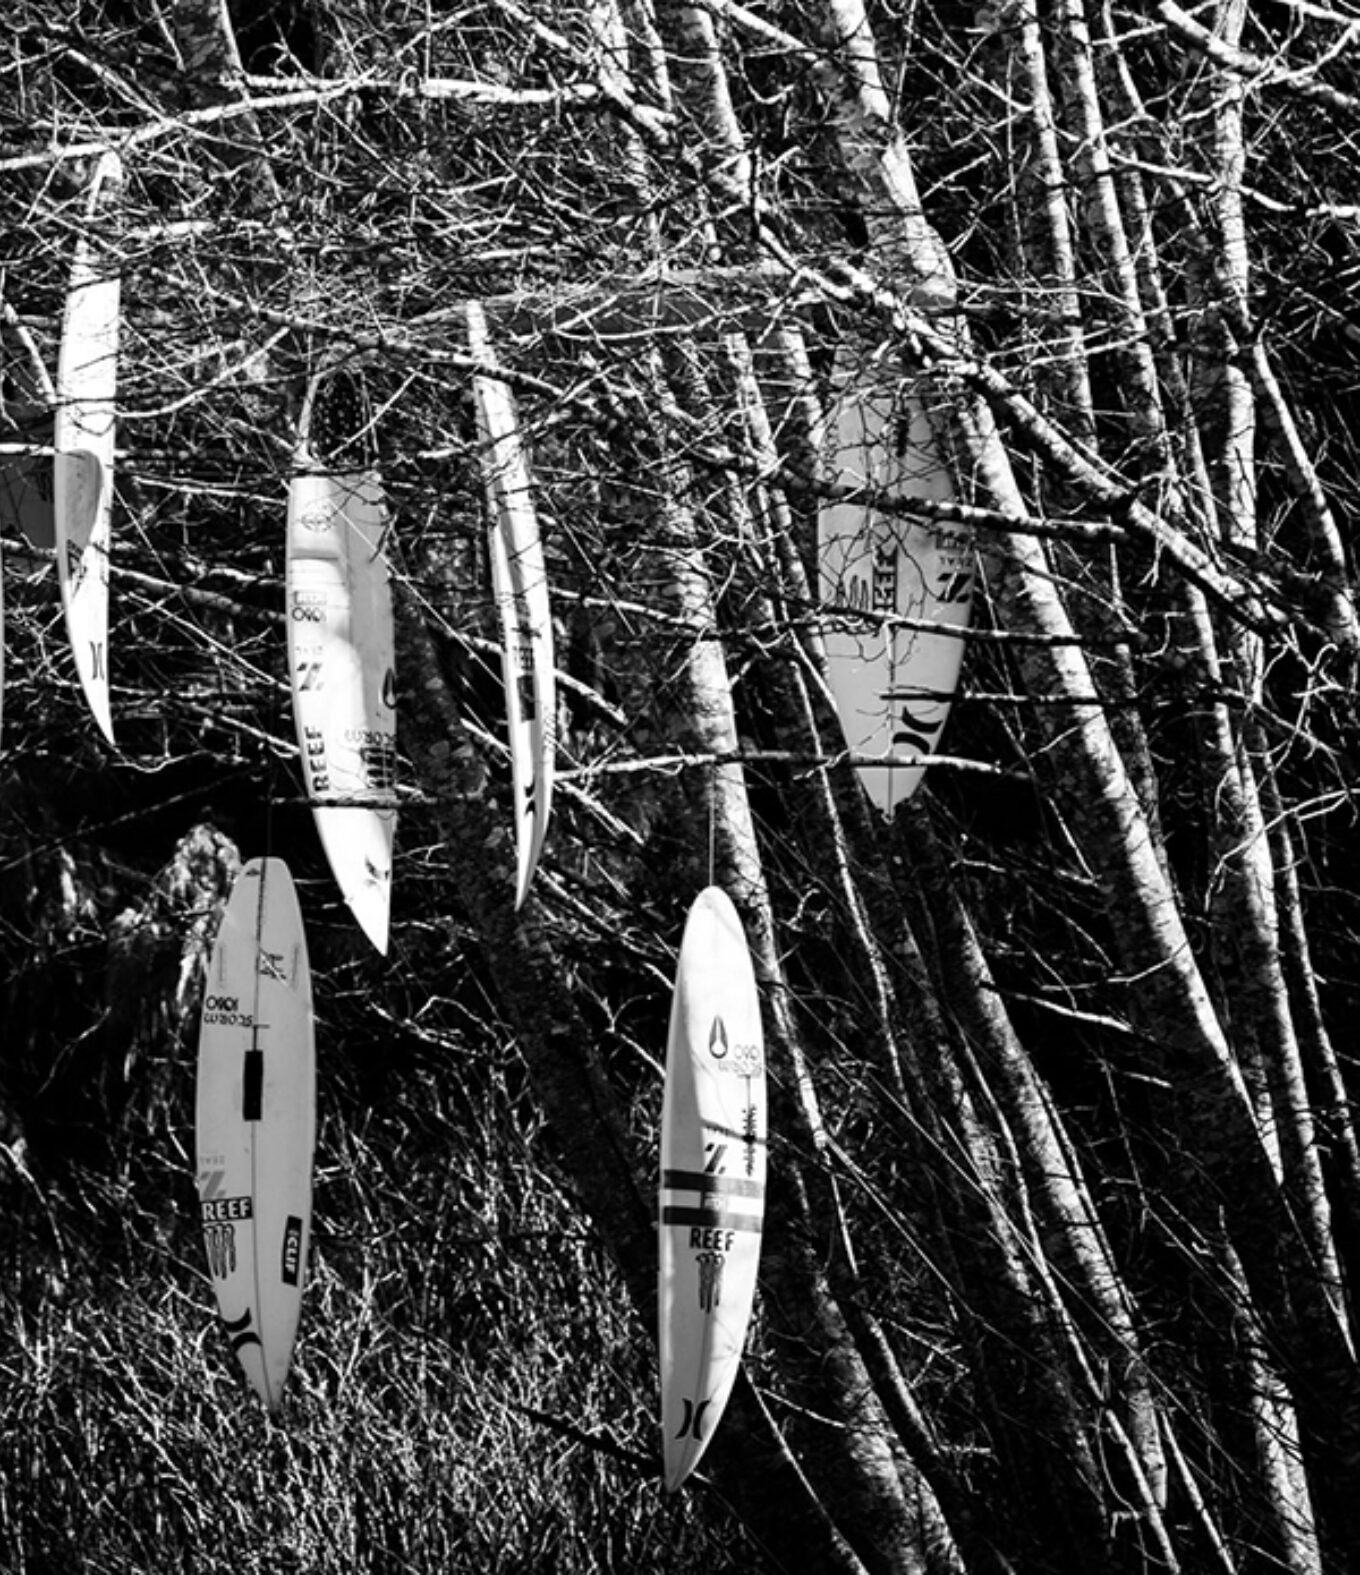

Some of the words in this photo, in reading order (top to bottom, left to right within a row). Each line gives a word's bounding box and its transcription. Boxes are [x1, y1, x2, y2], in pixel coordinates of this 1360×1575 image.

[304, 725, 330, 792] REEF
[202, 1198, 251, 1221] REEF
[690, 1228, 735, 1251] REEF
